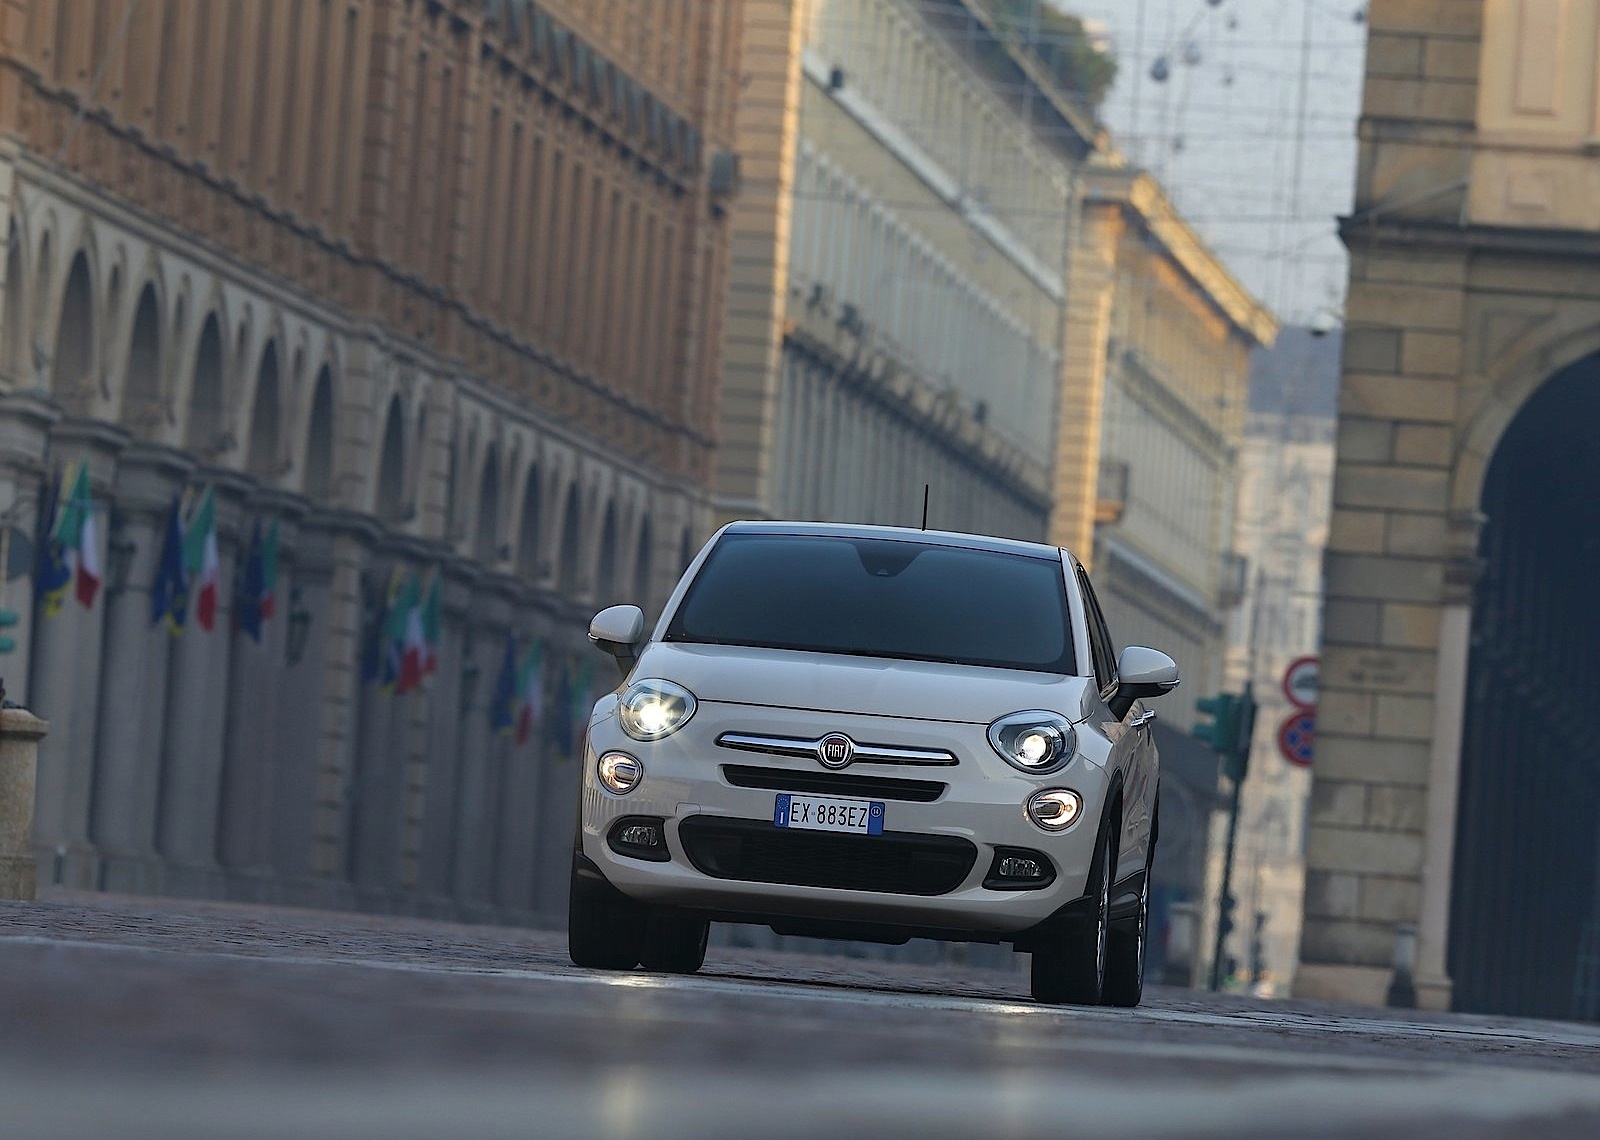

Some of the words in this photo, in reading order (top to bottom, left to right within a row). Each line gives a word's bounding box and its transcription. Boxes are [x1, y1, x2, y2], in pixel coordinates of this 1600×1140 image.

[827, 744, 844, 757] FIAT
[791, 802, 810, 822] EX
[817, 804, 868, 828] 883EZ
